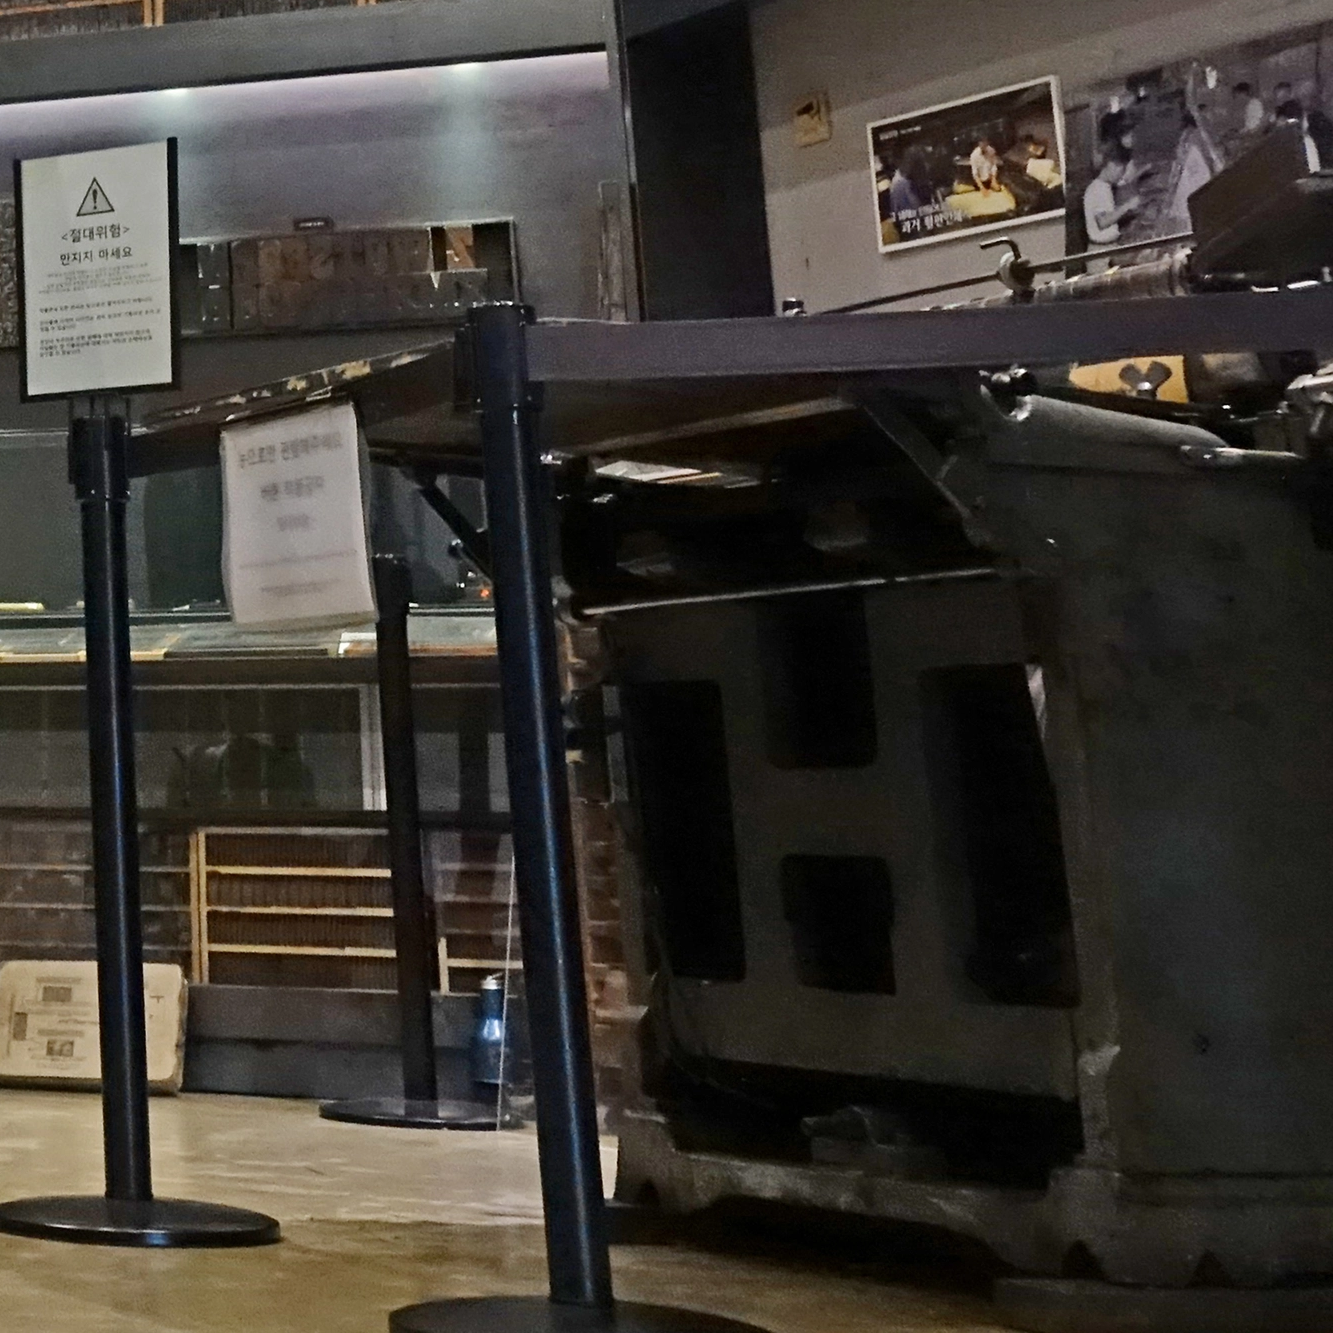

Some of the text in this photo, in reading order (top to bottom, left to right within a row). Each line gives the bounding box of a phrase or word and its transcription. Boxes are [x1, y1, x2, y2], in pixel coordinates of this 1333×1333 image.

[61, 223, 130, 243] <절대위험>
[60, 246, 132, 266] 만지지 마세요
